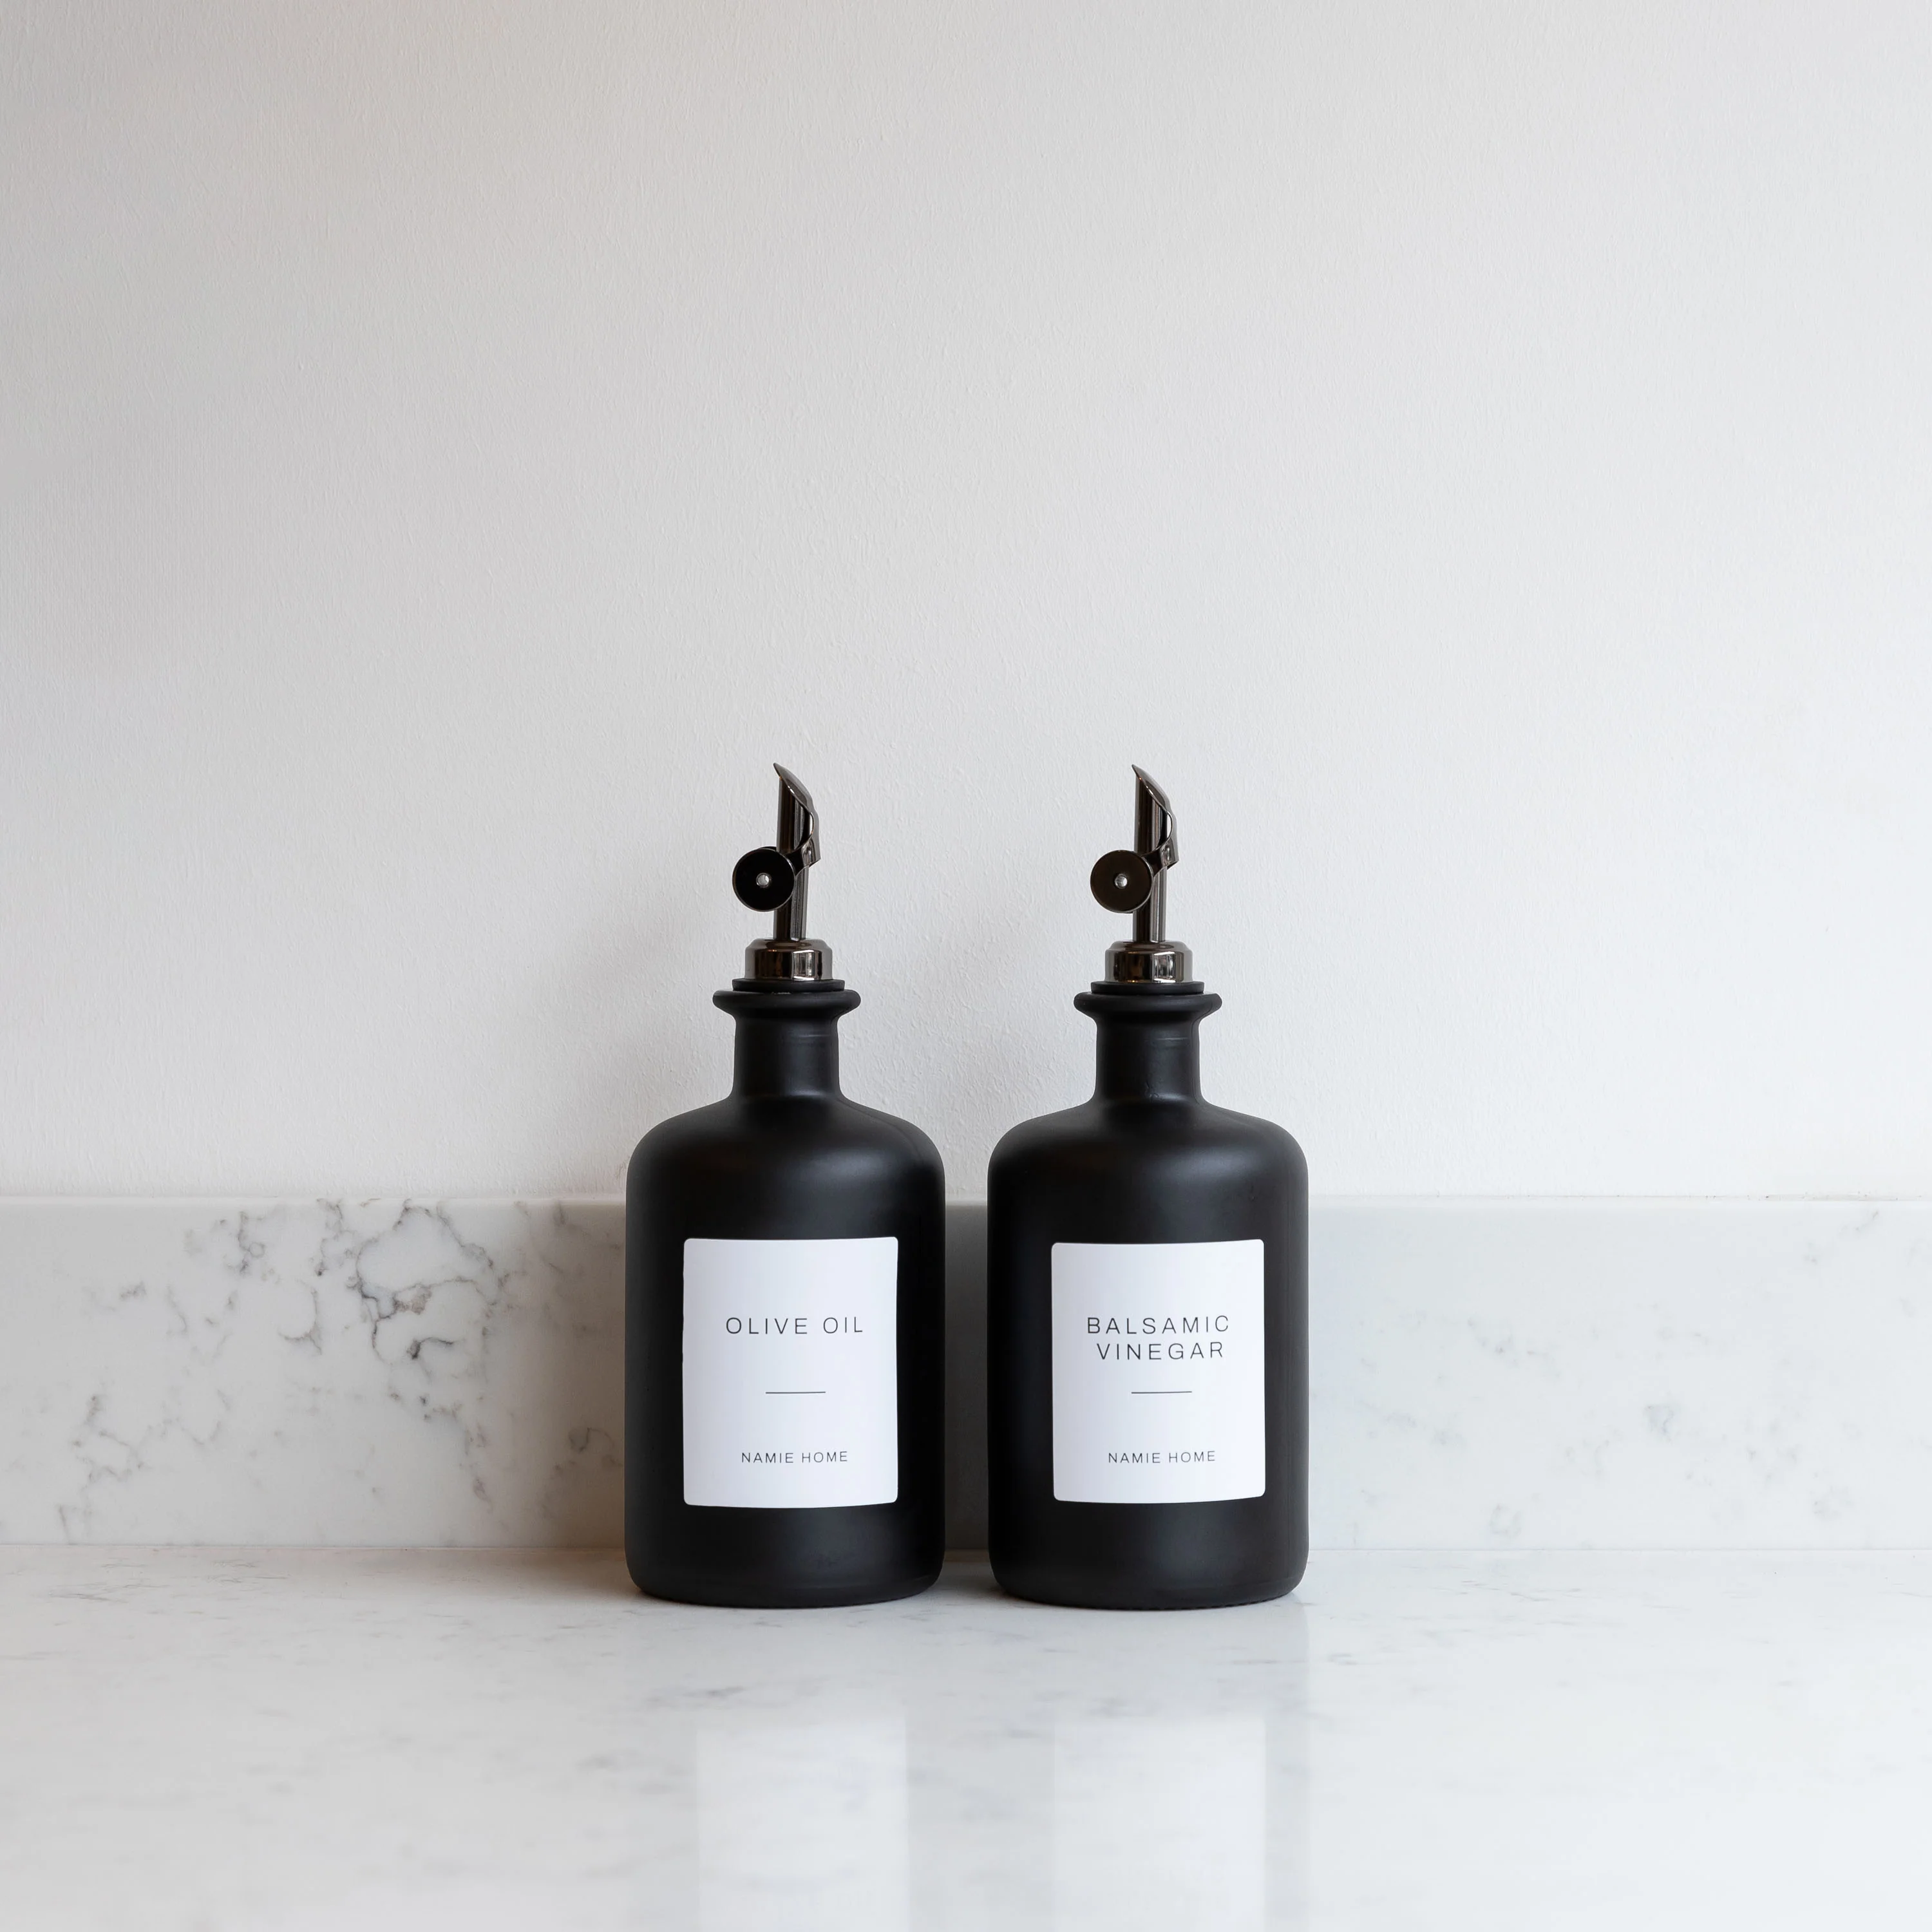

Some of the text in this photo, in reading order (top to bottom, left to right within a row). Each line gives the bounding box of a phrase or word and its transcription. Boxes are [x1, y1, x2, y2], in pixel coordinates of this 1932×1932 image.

[725, 1316, 864, 1335] OLIVE OIL
[1086, 1315, 1229, 1335] BALSAMIC
[1095, 1341, 1224, 1360] VINEGAR
[741, 1450, 848, 1464] NAMIE HOME
[1108, 1450, 1216, 1464] NAMIE HOME
